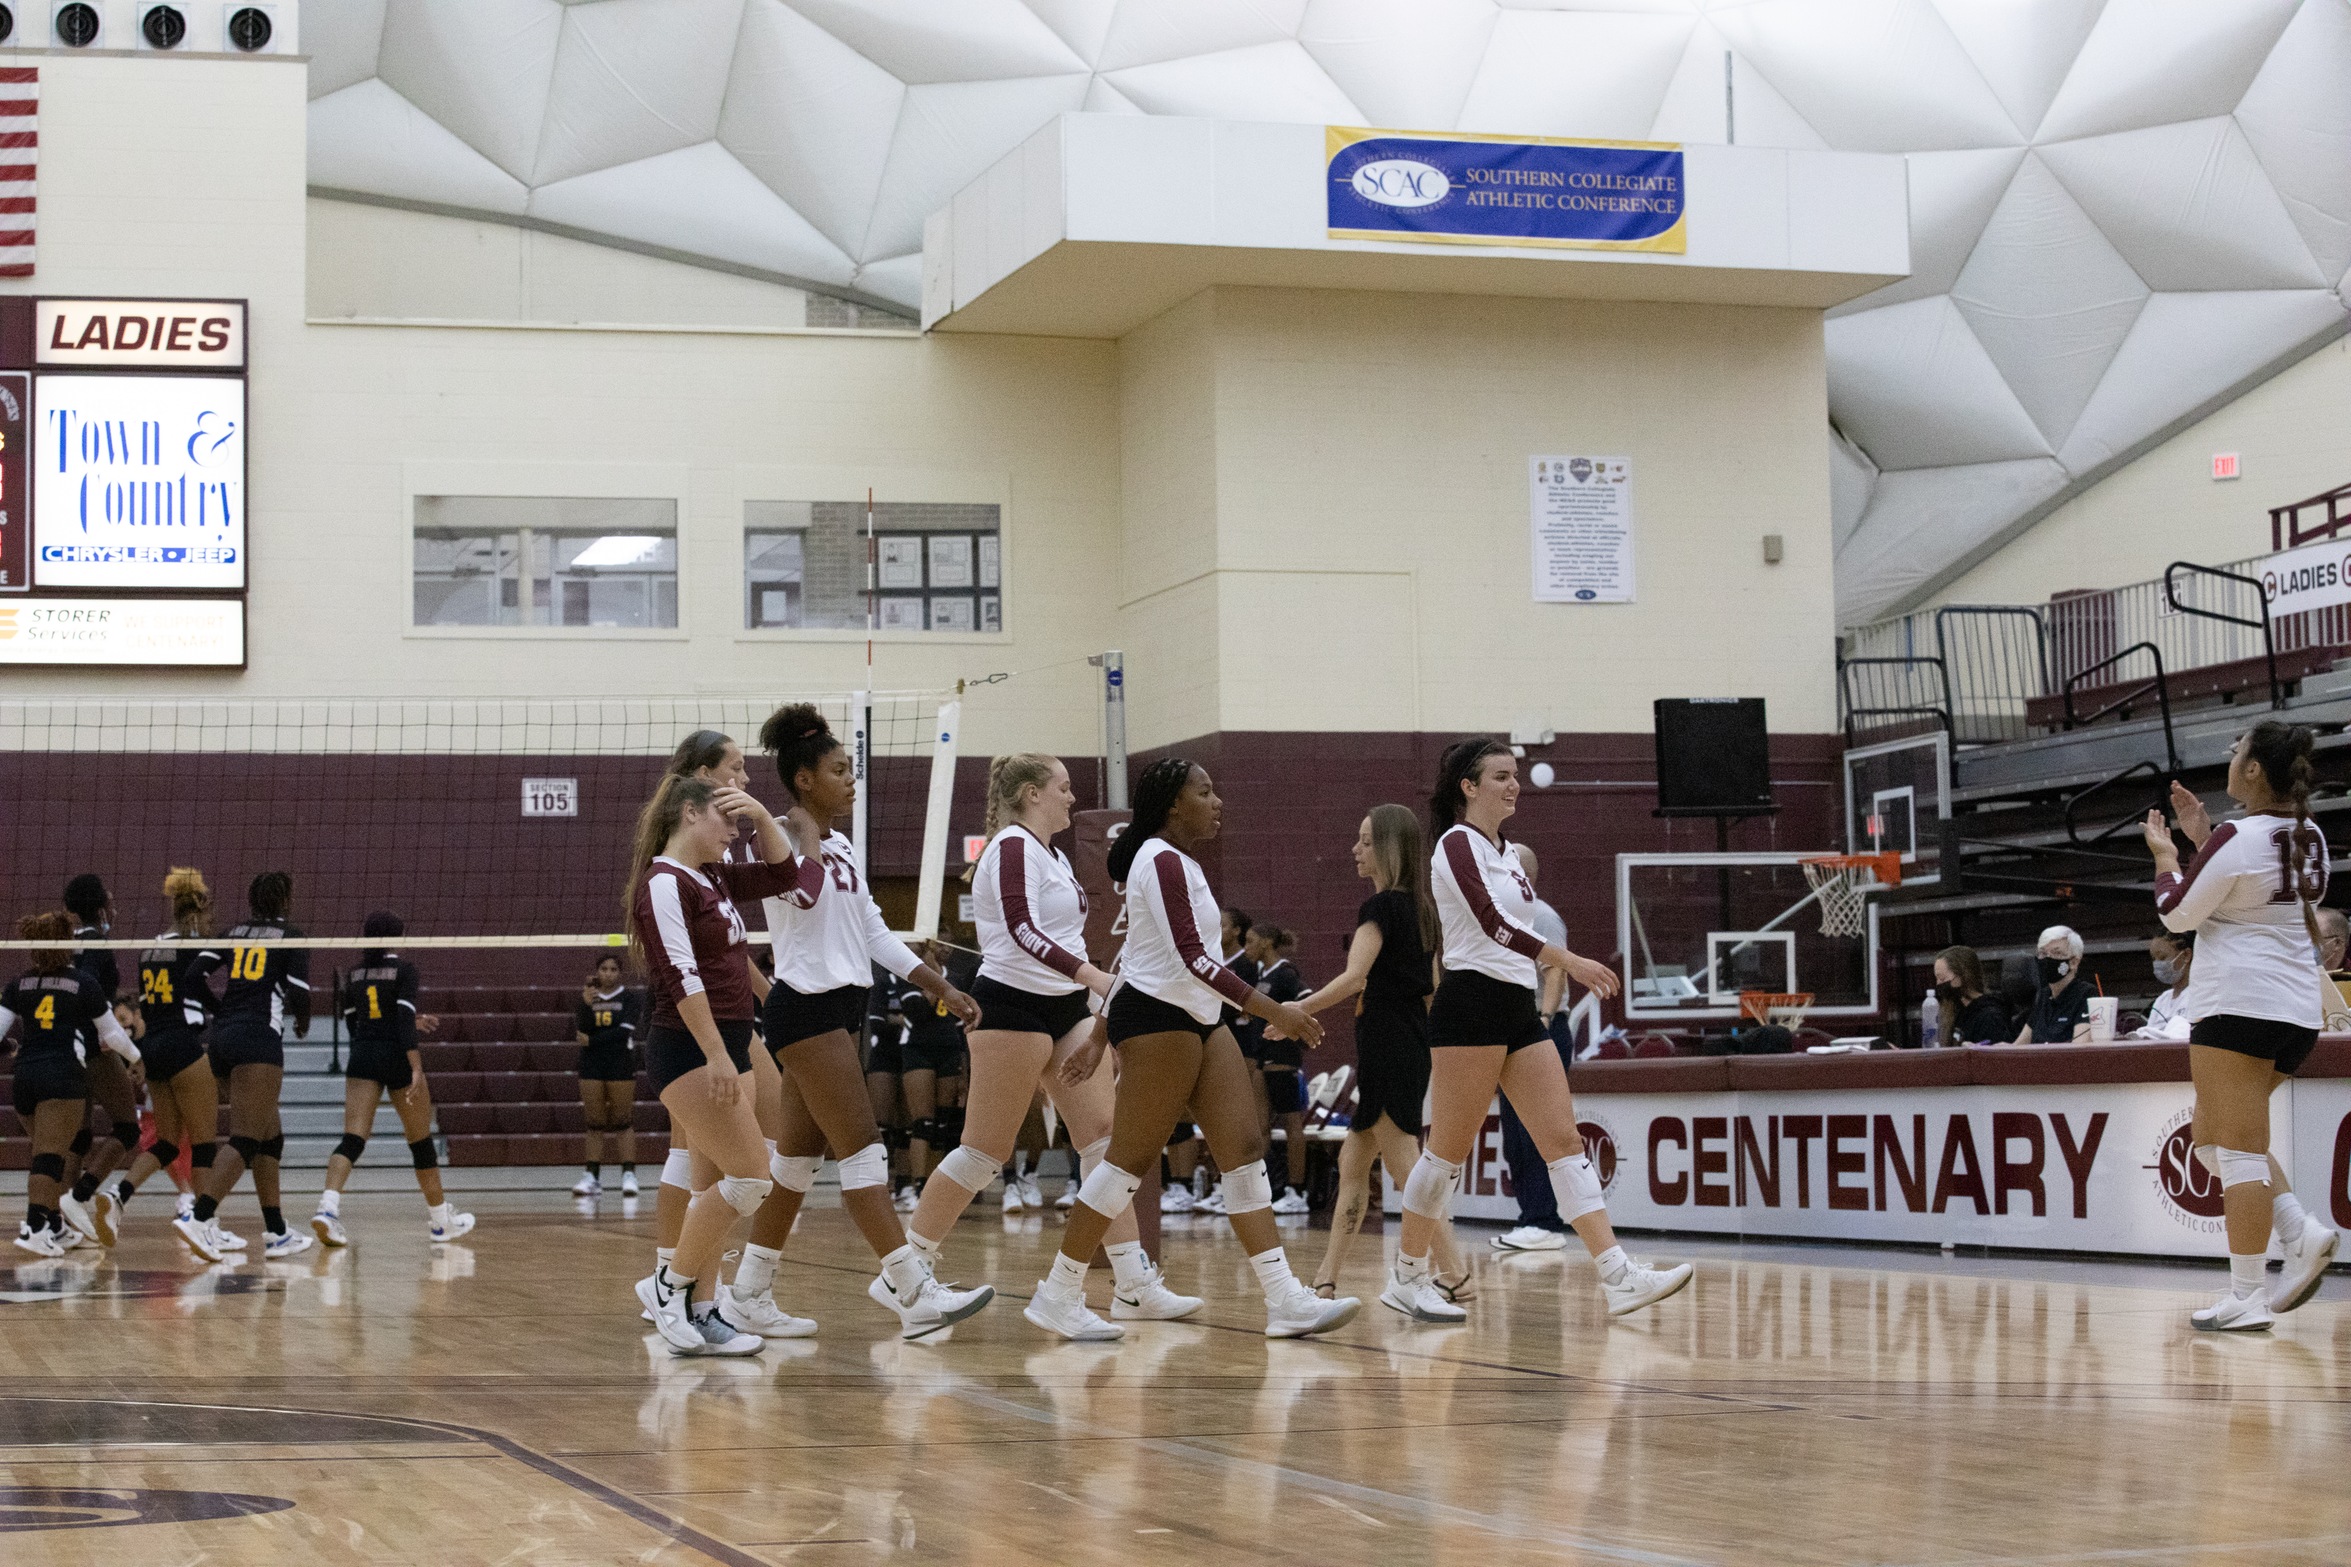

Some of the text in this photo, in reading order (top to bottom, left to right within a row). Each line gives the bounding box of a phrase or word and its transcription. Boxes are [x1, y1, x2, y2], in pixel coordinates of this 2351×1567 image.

[1362, 167, 1440, 199] SCAC
[1466, 168, 1677, 192] SOUTHERN COLLEGIATE
[1466, 190, 1677, 214] ATHLETIC CONFERENCE
[50, 315, 231, 352] LADIES
[49, 410, 235, 473] Town &
[2214, 456, 2236, 476] EXIT
[80, 471, 238, 542] Country
[45, 546, 234, 563] CHRYSLER JEEP
[2280, 562, 2337, 596] LADIES
[28, 627, 108, 640] Services
[32, 609, 111, 623] STORER
[856, 740, 864, 779] Schelde
[530, 784, 568, 792] SECTION
[531, 793, 567, 810] 105
[821, 852, 859, 894] 27
[1015, 921, 1053, 959] LADIES
[230, 946, 267, 981] 10
[142, 968, 173, 1004] 24
[366, 985, 382, 1019] 1
[34, 994, 55, 1030] 4
[2152, 1106, 2195, 1160] SOUTHER
[1648, 1112, 2109, 1219] CENTENARY
[2167, 1137, 2224, 1198] SC
[2152, 1180, 2198, 1232] ATHLETIC
